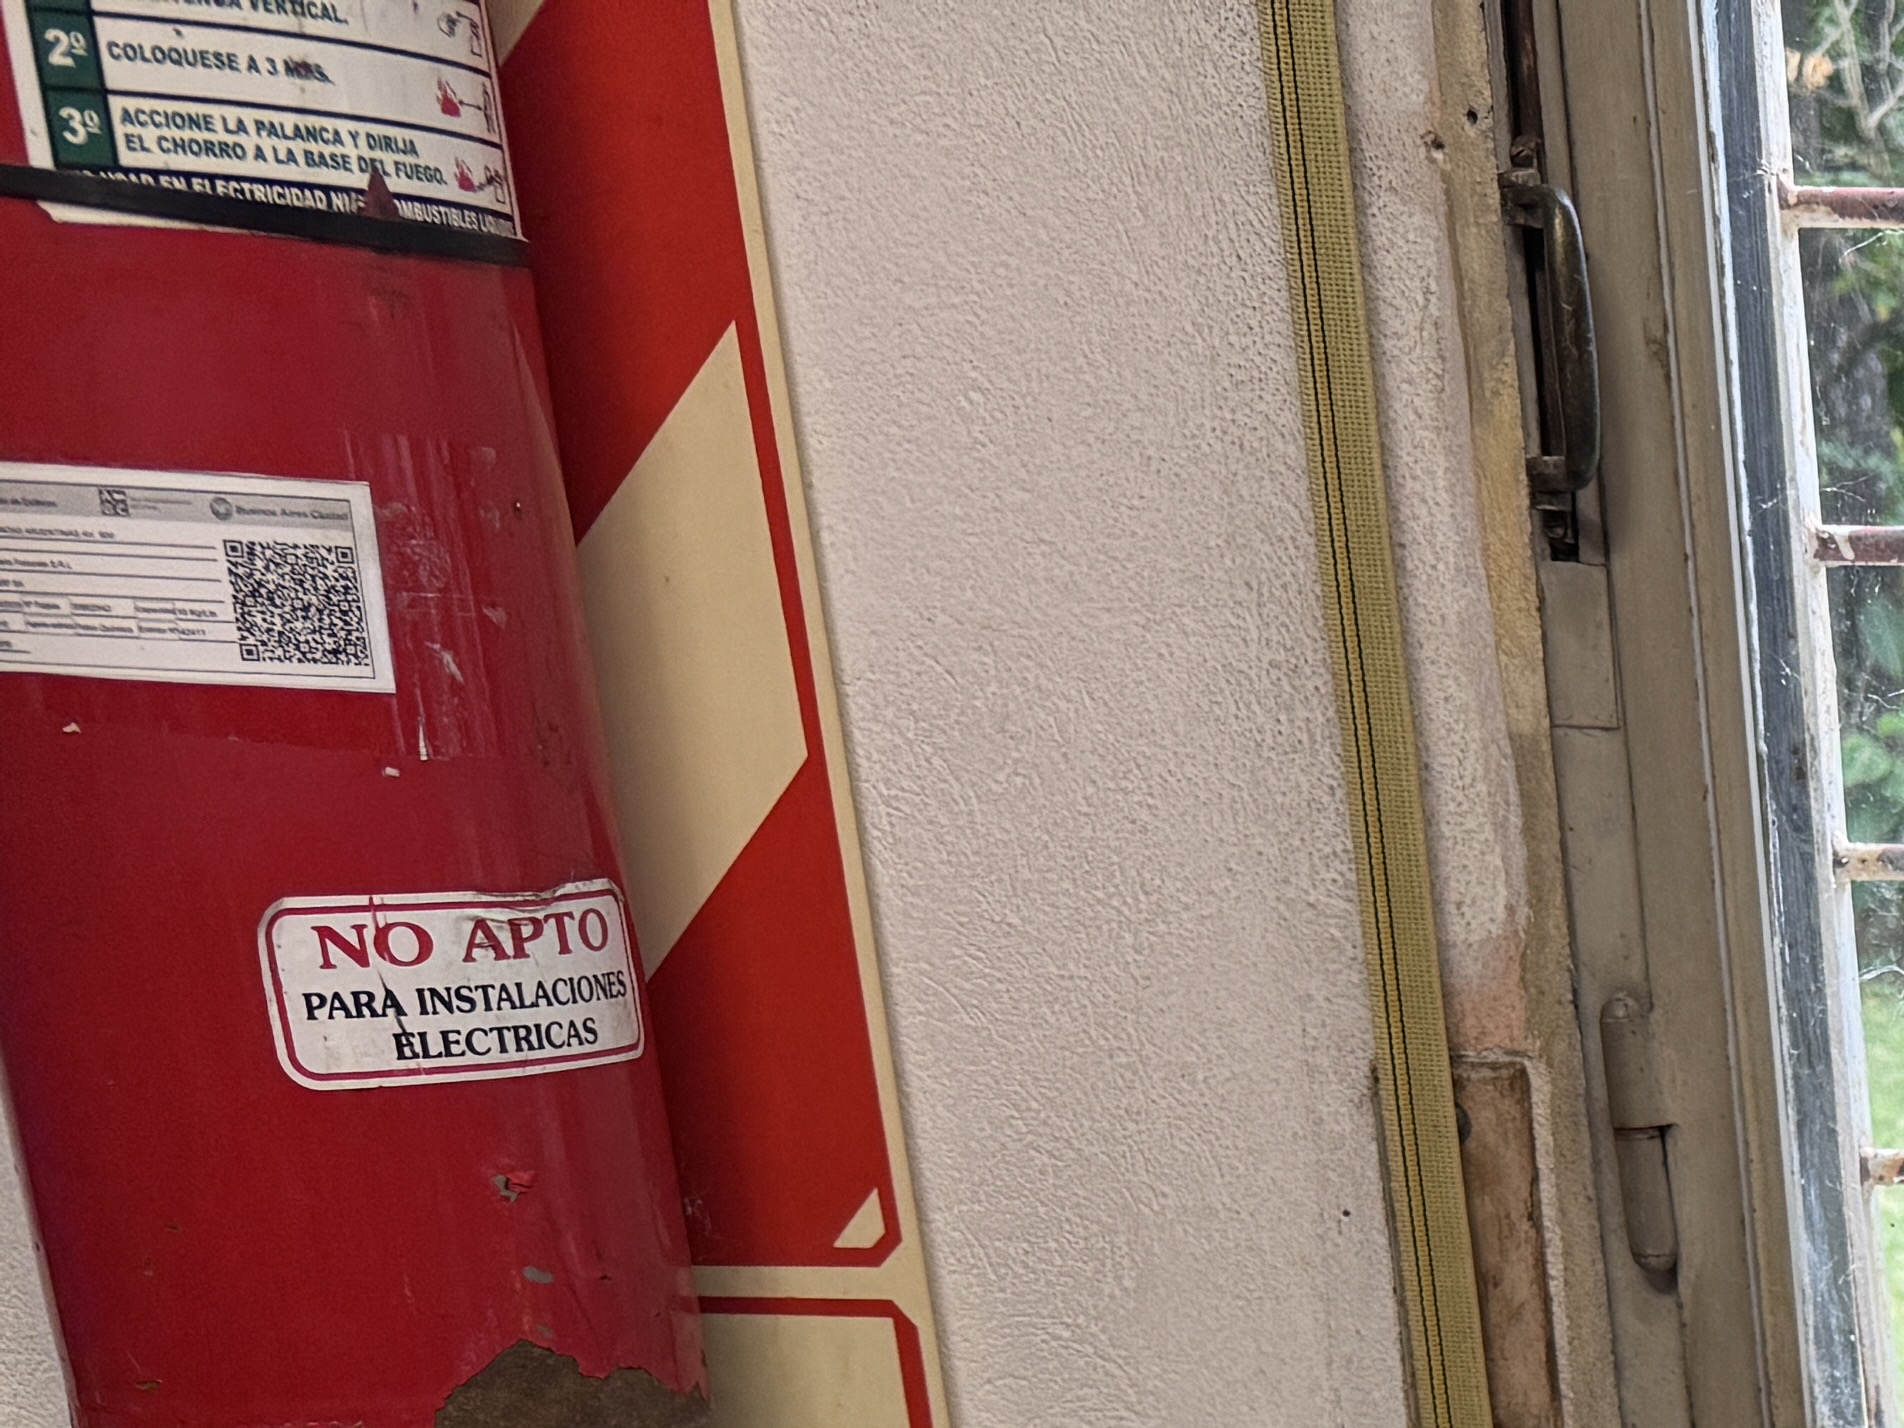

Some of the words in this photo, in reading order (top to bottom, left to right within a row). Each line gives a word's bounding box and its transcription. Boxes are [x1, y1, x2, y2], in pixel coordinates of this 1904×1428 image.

[106, 41, 242, 72] COLOQUESE
[247, 57, 261, 75] A
[266, 57, 279, 77] 3
[120, 107, 218, 134] ACCIONE
[220, 115, 250, 137] LA
[253, 118, 346, 148] PALANCA
[348, 130, 359, 150] Y
[365, 133, 420, 159] DIRIJA
[124, 133, 152, 154] EL
[156, 135, 247, 162] CHORRO
[253, 144, 267, 163] A
[272, 145, 299, 166] LA
[302, 149, 355, 174] BASE
[358, 157, 392, 178] DEL
[311, 921, 434, 969] NO
[462, 907, 609, 965] APTO
[302, 988, 408, 1021] PARA
[415, 969, 627, 1017] INSTALACIONES
[393, 1016, 598, 1061] ELECTRICAS
